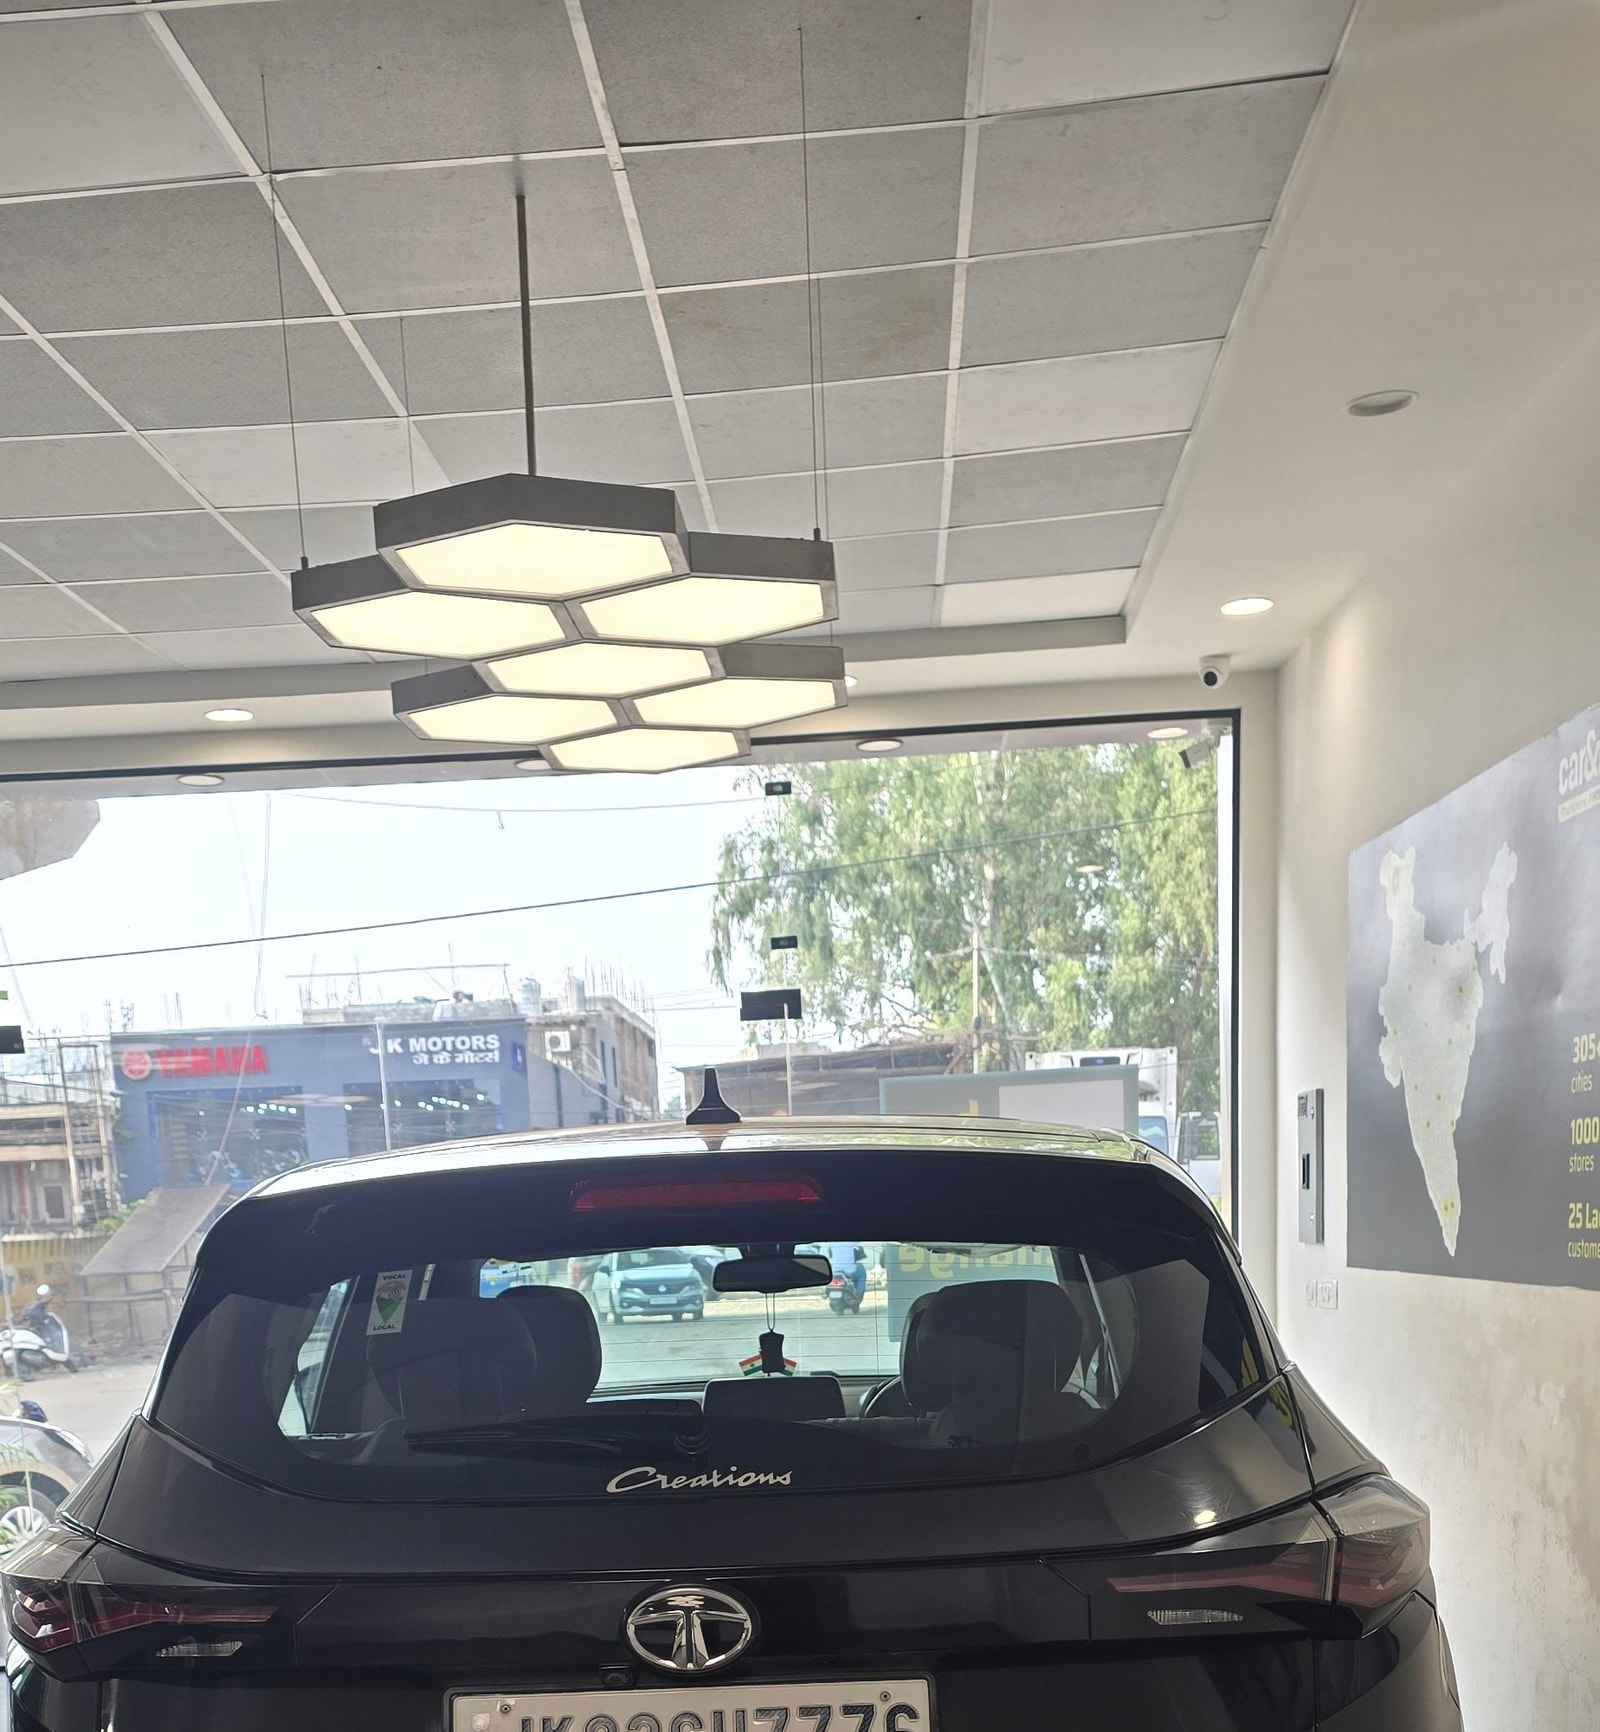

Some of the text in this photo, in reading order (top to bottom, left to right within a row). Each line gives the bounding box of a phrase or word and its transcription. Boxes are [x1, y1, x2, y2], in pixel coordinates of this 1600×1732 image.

[1559, 728, 1600, 795] car&
[387, 1038, 404, 1054] K
[409, 1034, 500, 1053] MOTORS
[155, 1044, 269, 1078] YAMAHA
[1571, 1070, 1593, 1093] cities
[1568, 1152, 1595, 1173] stores
[1568, 1202, 1600, 1229] 25 La
[383, 1273, 407, 1281] VOCAL
[372, 1323, 397, 1331] LOCAL
[606, 1466, 793, 1493] Creations
